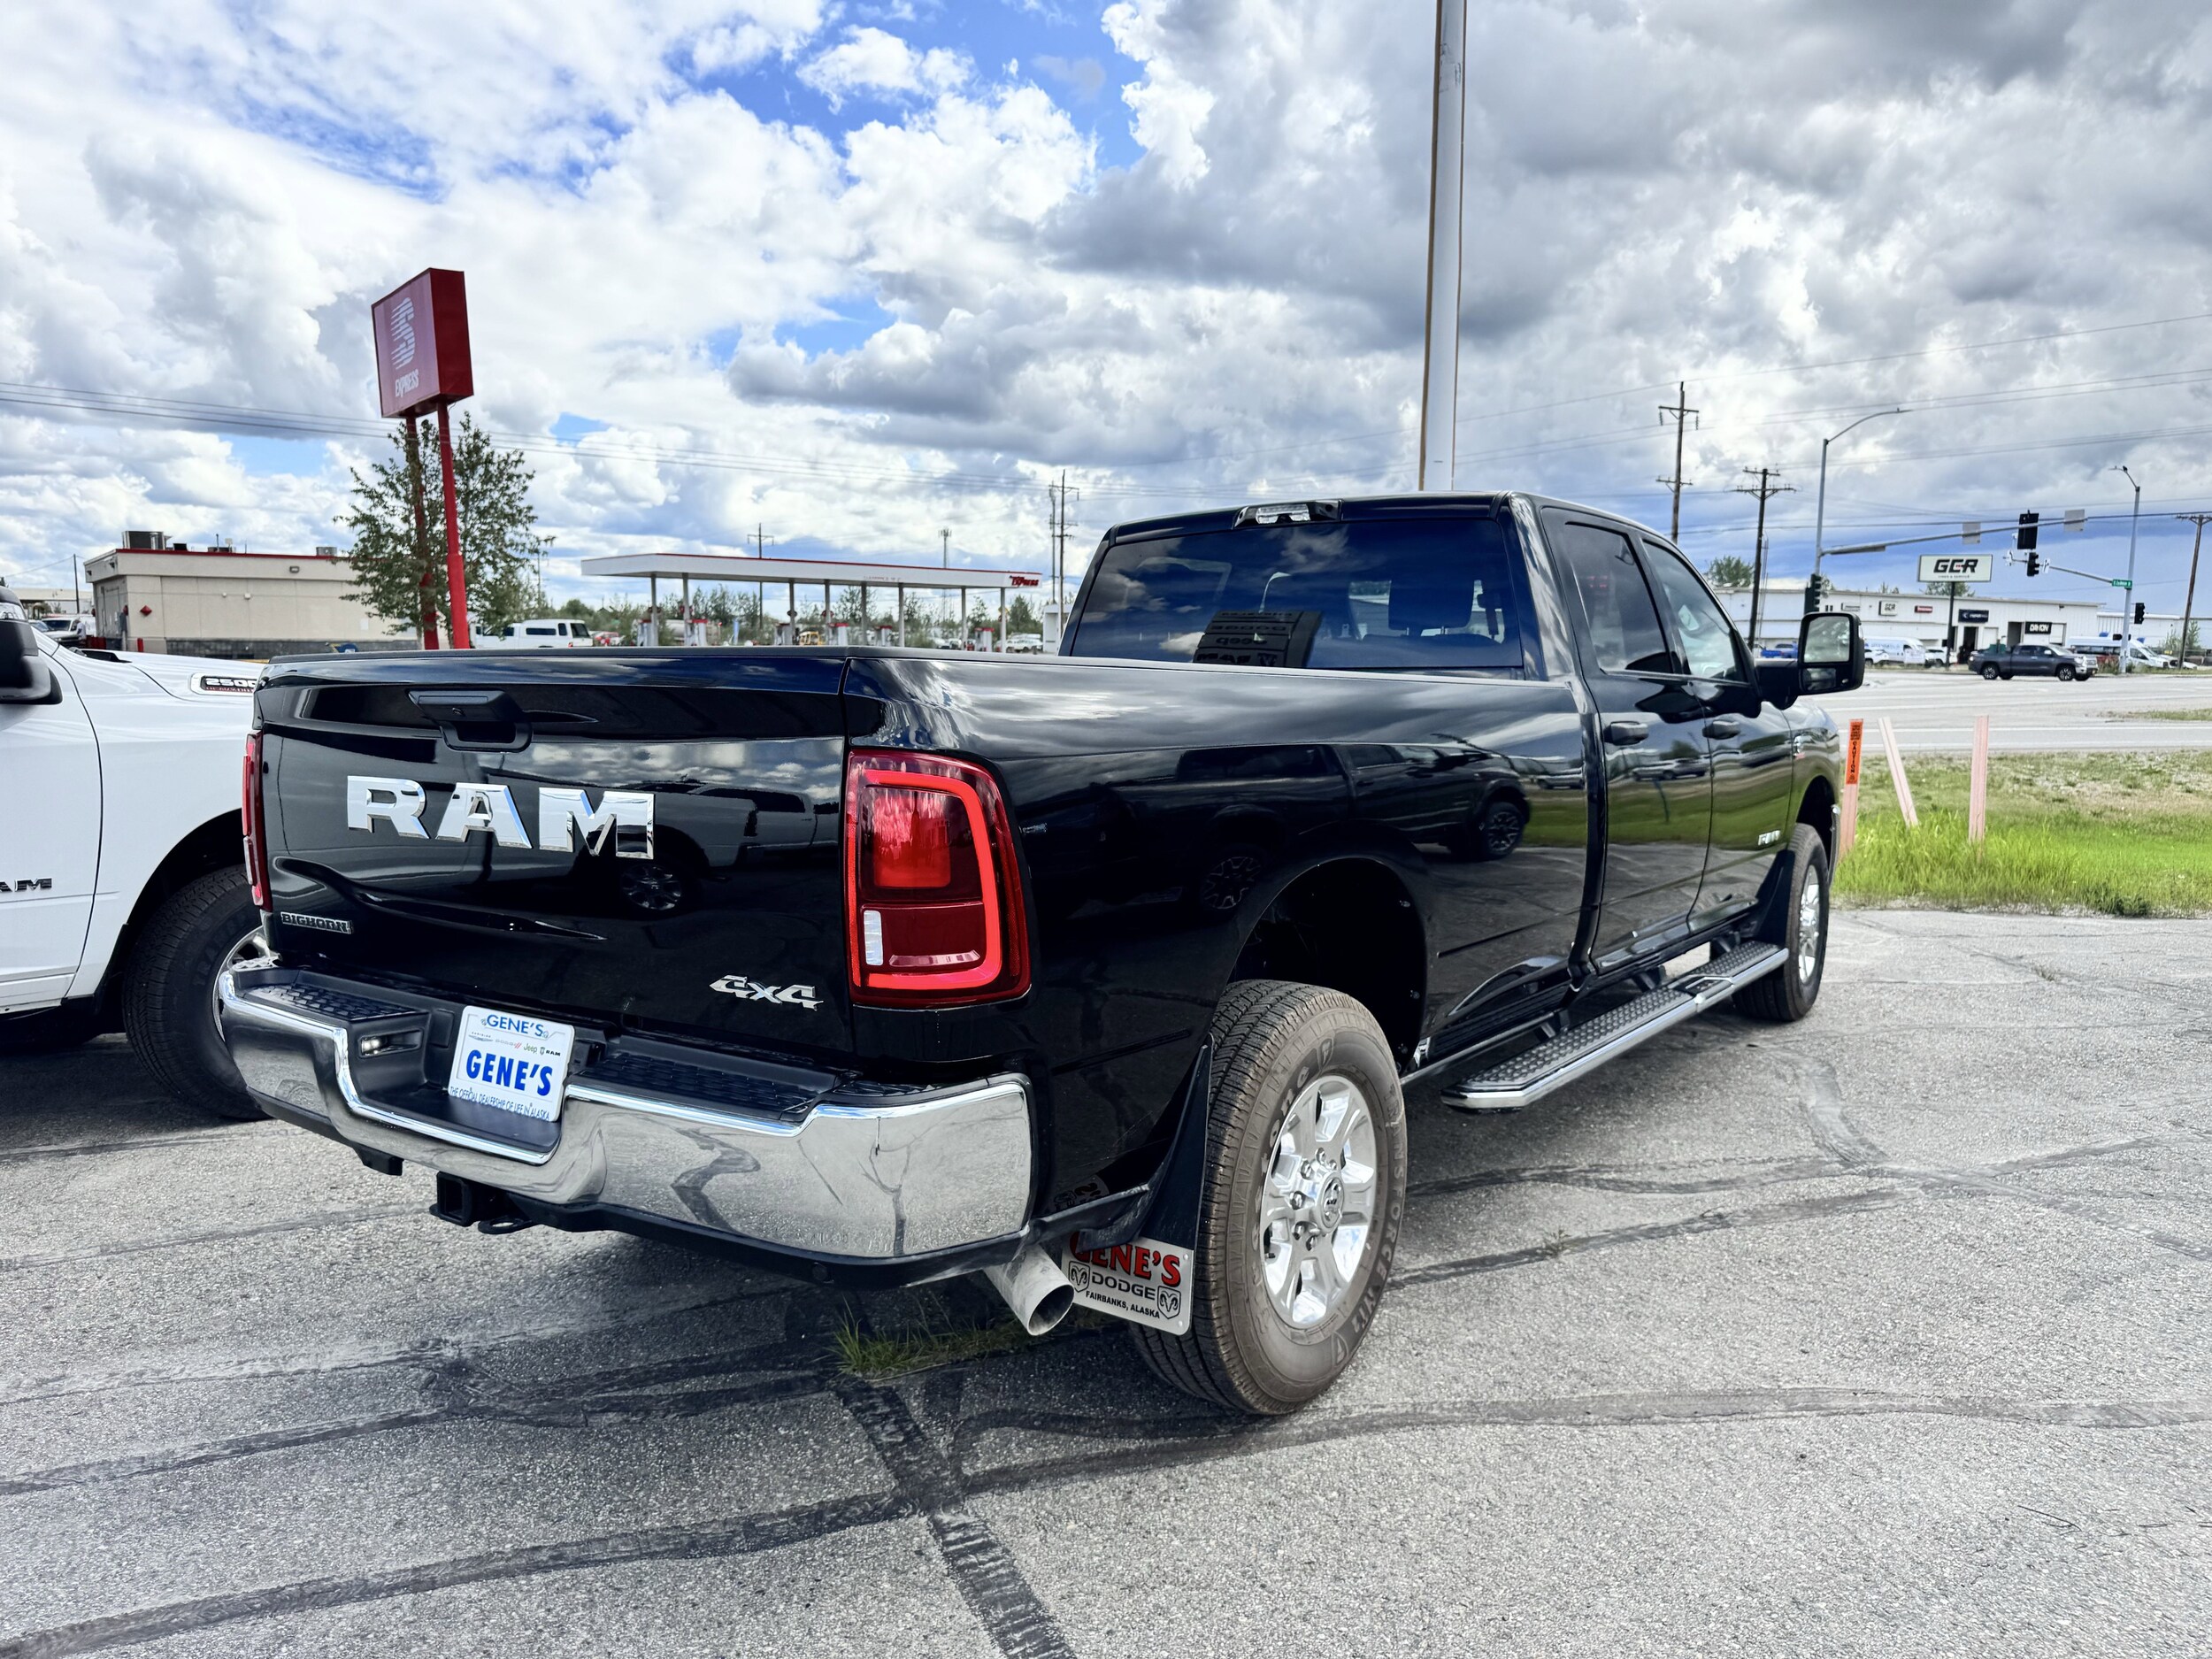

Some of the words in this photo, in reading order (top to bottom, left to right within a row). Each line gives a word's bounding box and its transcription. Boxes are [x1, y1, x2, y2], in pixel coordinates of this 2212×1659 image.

[1933, 558, 1978, 573] GCR
[348, 775, 656, 859] RAM
[281, 912, 349, 933] BIGHORN
[487, 1014, 544, 1037] GENE'S
[465, 1049, 553, 1096] GENE'S
[1091, 1271, 1156, 1301] DODGE
[1085, 1290, 1129, 1311] FAIRBANKS,
[1130, 1303, 1160, 1318] ALASKA
